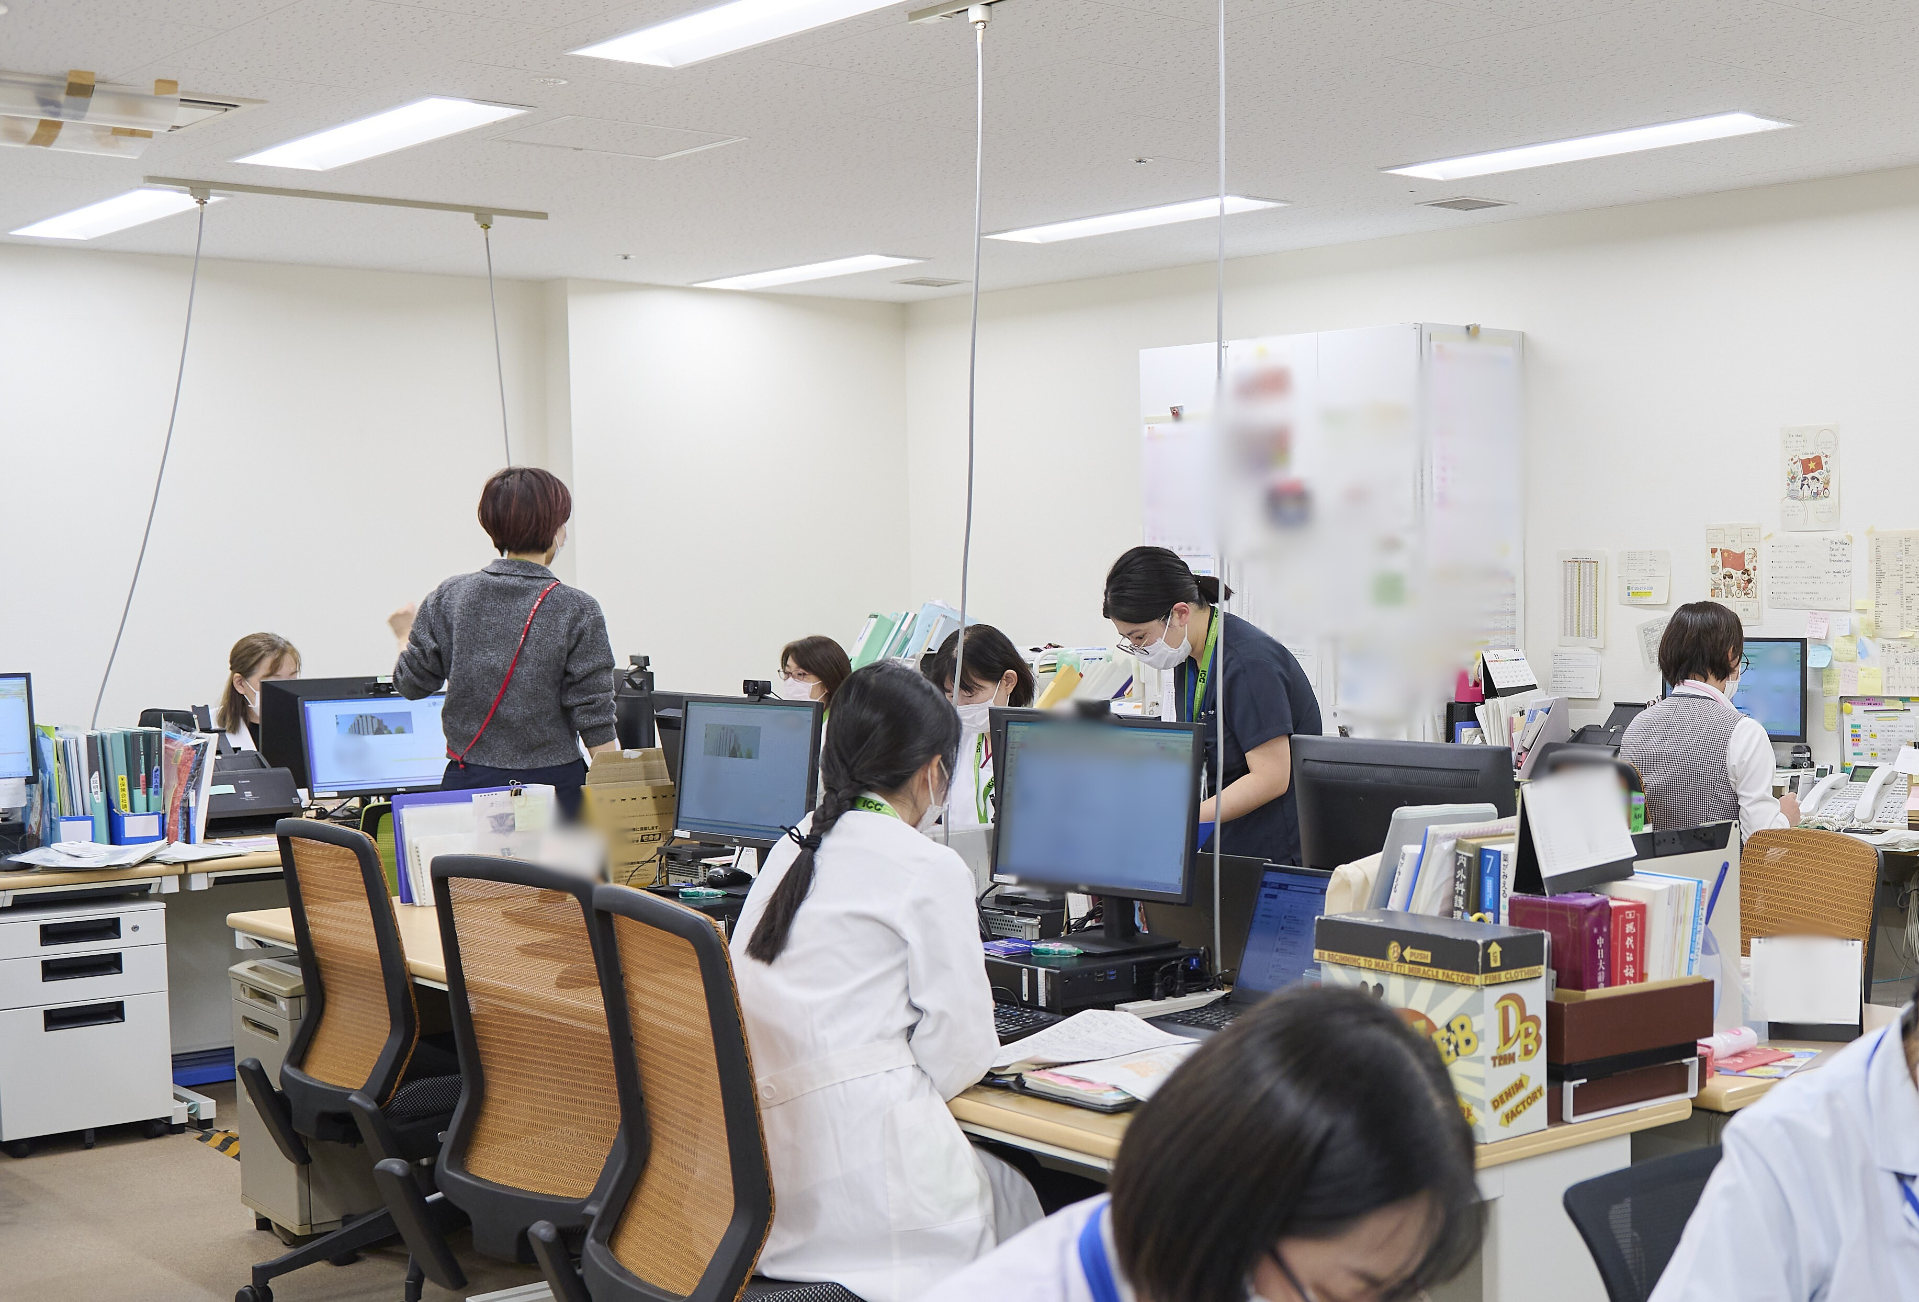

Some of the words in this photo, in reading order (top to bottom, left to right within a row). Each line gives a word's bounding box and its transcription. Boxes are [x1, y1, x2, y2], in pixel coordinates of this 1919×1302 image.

[1199, 669, 1207, 684] ICC
[862, 799, 884, 812] ICC
[1485, 855, 1494, 874] 7
[1409, 951, 1429, 961] PUSH
[1327, 952, 1361, 966] BEGINNING
[1363, 961, 1373, 970] TO
[1374, 961, 1394, 973] MAKE
[1408, 966, 1439, 978] MIRACLE
[1441, 971, 1476, 985] FACTORY
[1484, 973, 1502, 984] FINE
[1504, 967, 1542, 980] CLOTHING
[1491, 1078, 1525, 1111] DENIM
[1504, 1085, 1544, 1125] FACTORY
